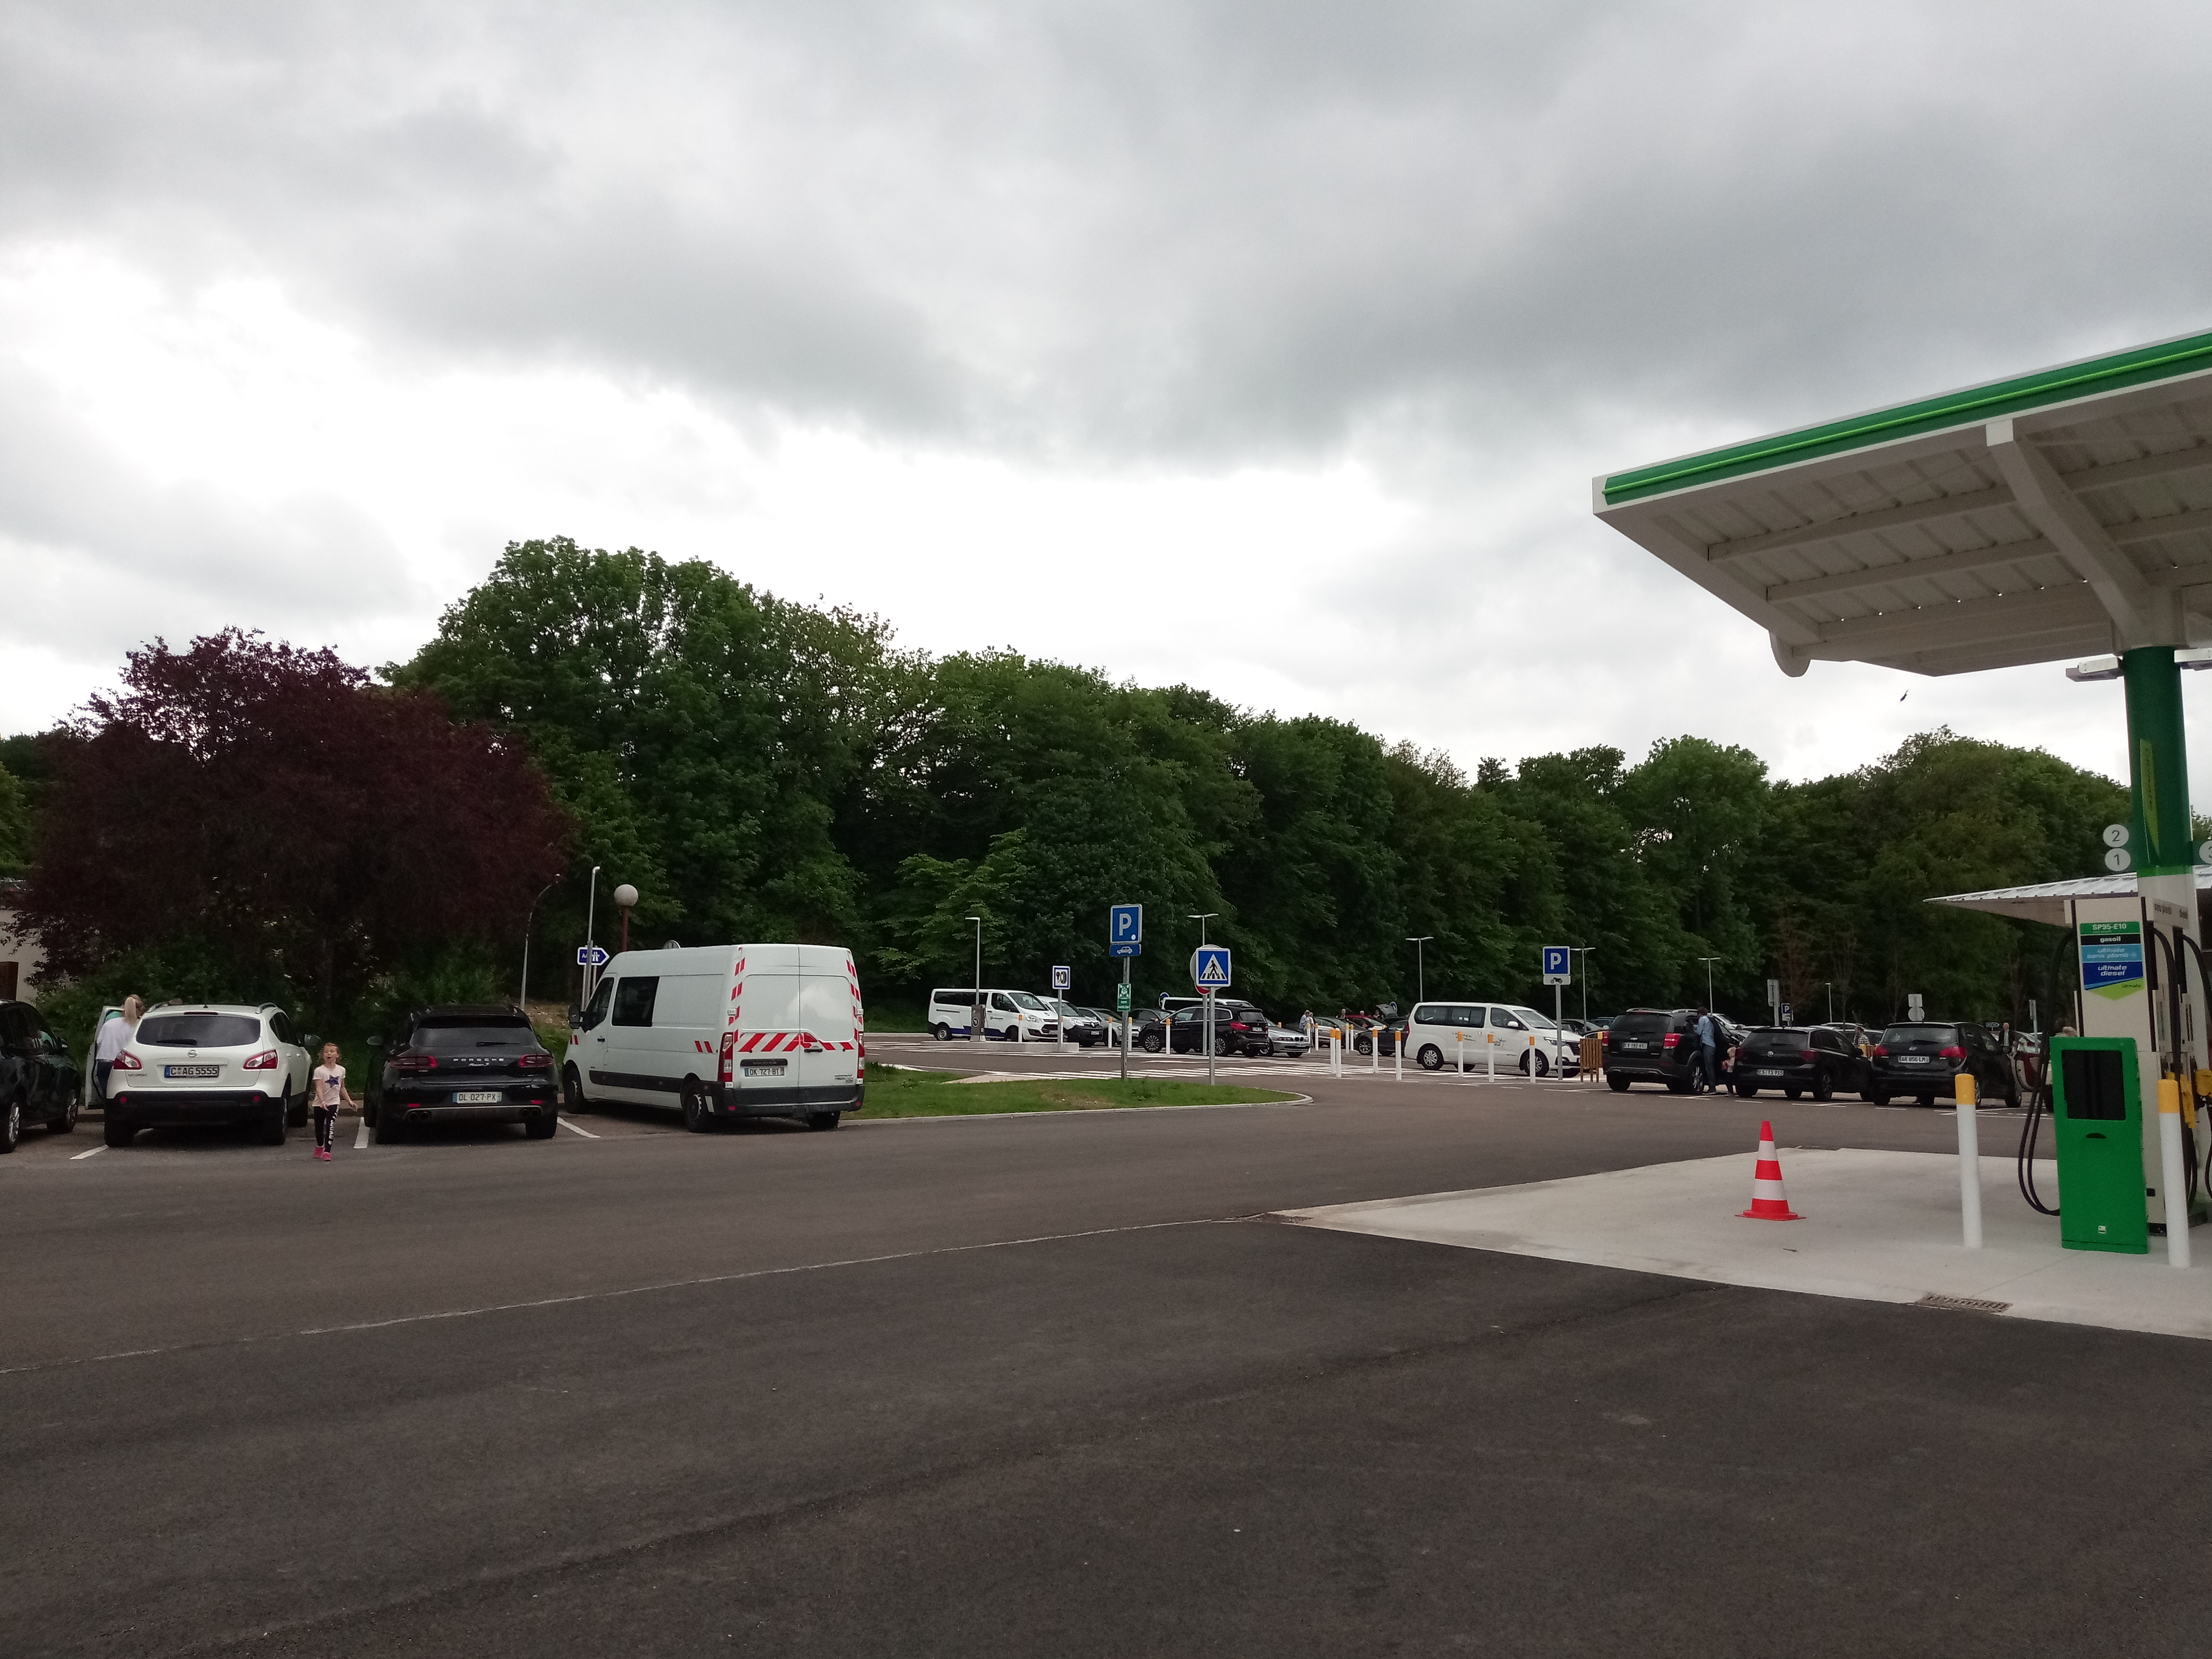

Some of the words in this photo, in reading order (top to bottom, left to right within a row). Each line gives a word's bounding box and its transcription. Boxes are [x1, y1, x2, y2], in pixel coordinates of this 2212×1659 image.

[2112, 830, 2120, 842] 2
[2114, 854, 2120, 866] 1
[1119, 914, 1132, 936] P
[1551, 953, 1562, 970] P
